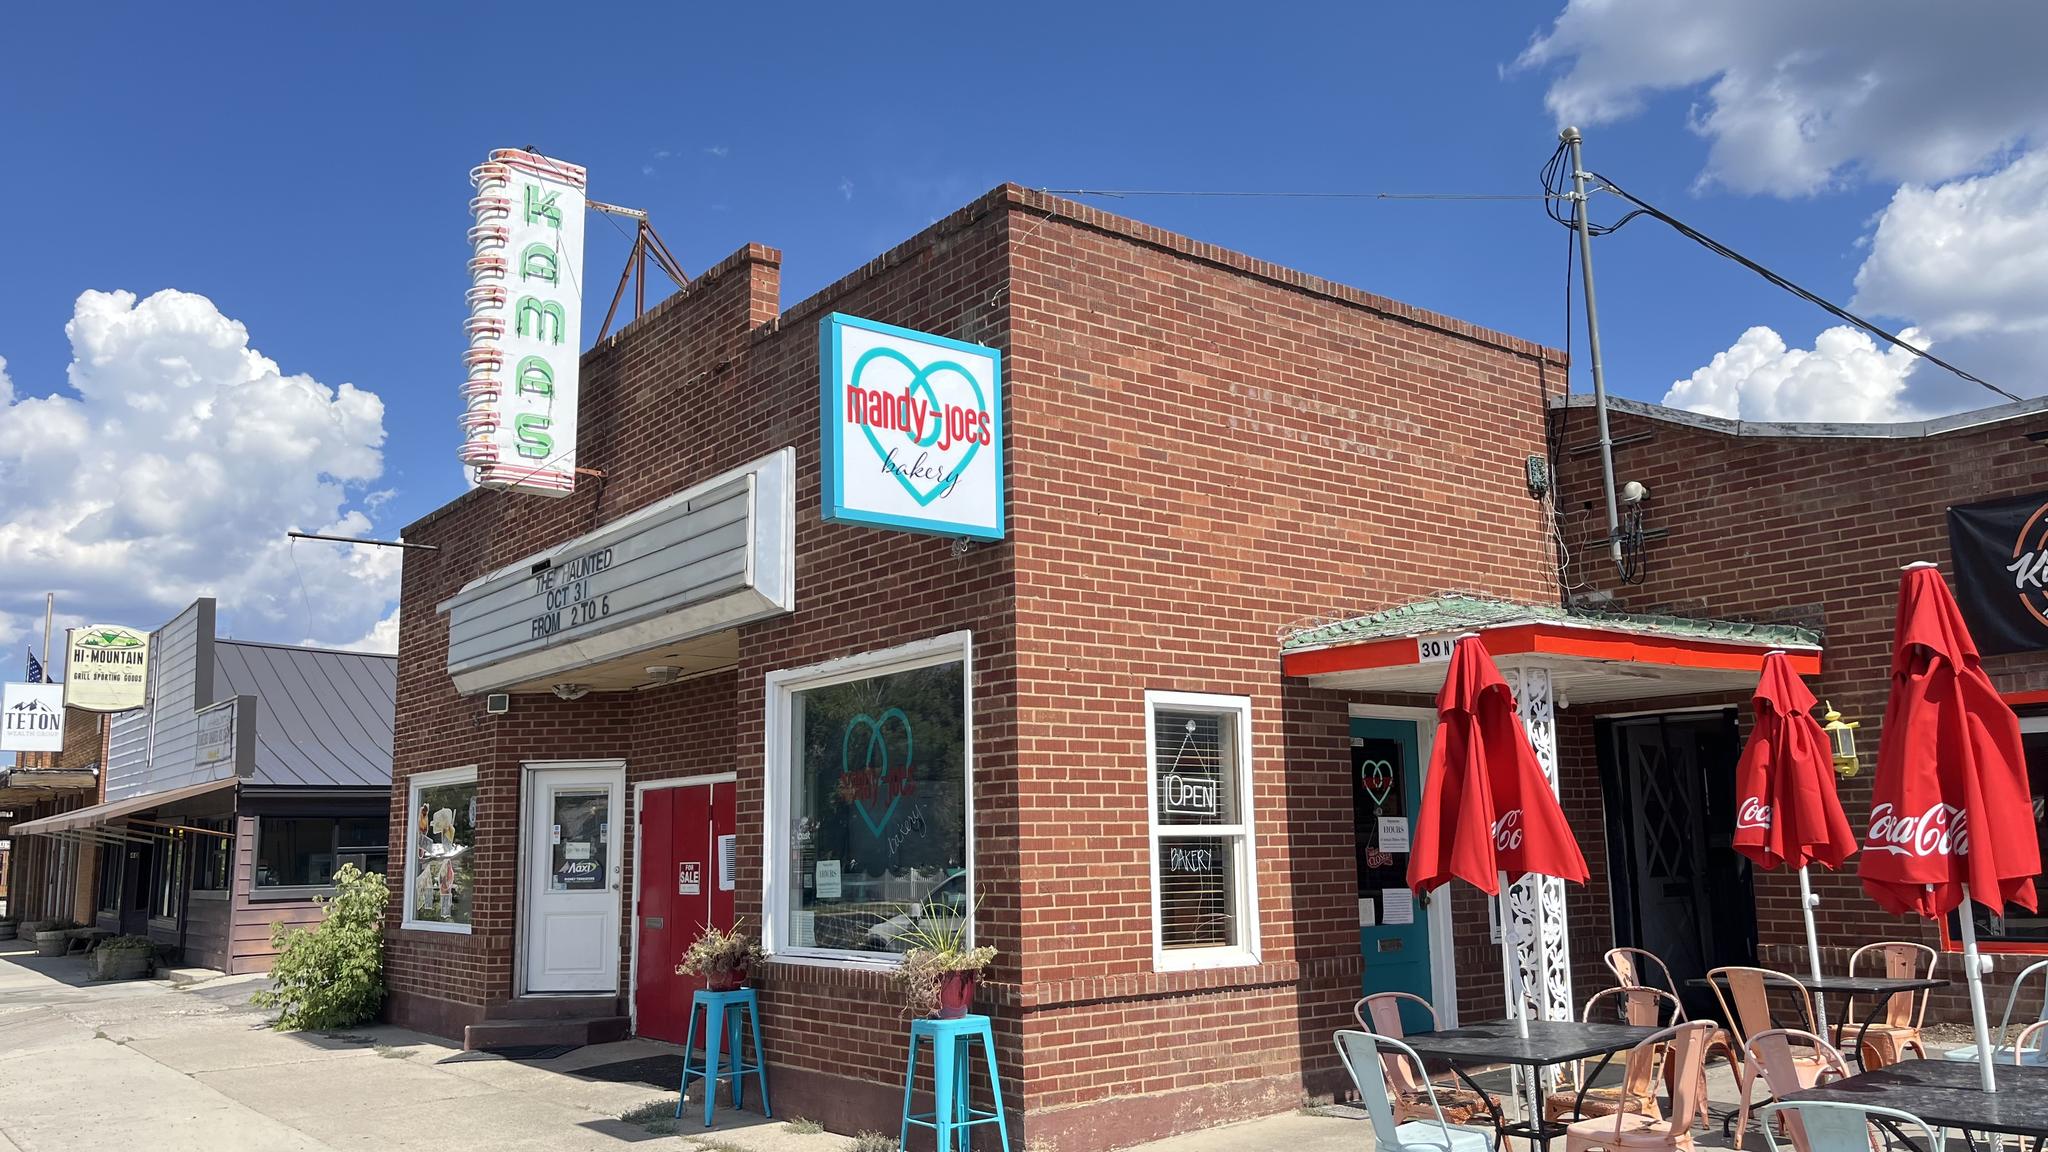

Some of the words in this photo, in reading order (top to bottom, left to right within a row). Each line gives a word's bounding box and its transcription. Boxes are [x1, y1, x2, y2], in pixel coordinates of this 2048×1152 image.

[847, 384, 991, 451] mandy-joes
[881, 447, 962, 499] bakery
[535, 571, 554, 594] THE
[546, 586, 569, 611] OCT
[574, 580, 588, 602] 31
[531, 612, 561, 638] FROM
[571, 606, 578, 626] 2
[581, 600, 596, 622] TO
[601, 595, 610, 616] 6
[1422, 641, 1441, 658] 30
[1444, 640, 1450, 656] N
[73, 672, 90, 681] GRILL
[93, 673, 121, 682] SPORTING
[123, 674, 143, 682] GOODS
[4, 711, 61, 731] TETON
[888, 803, 927, 857] bakery
[1170, 848, 1212, 872] BAKERY
[680, 871, 699, 884] SALE
